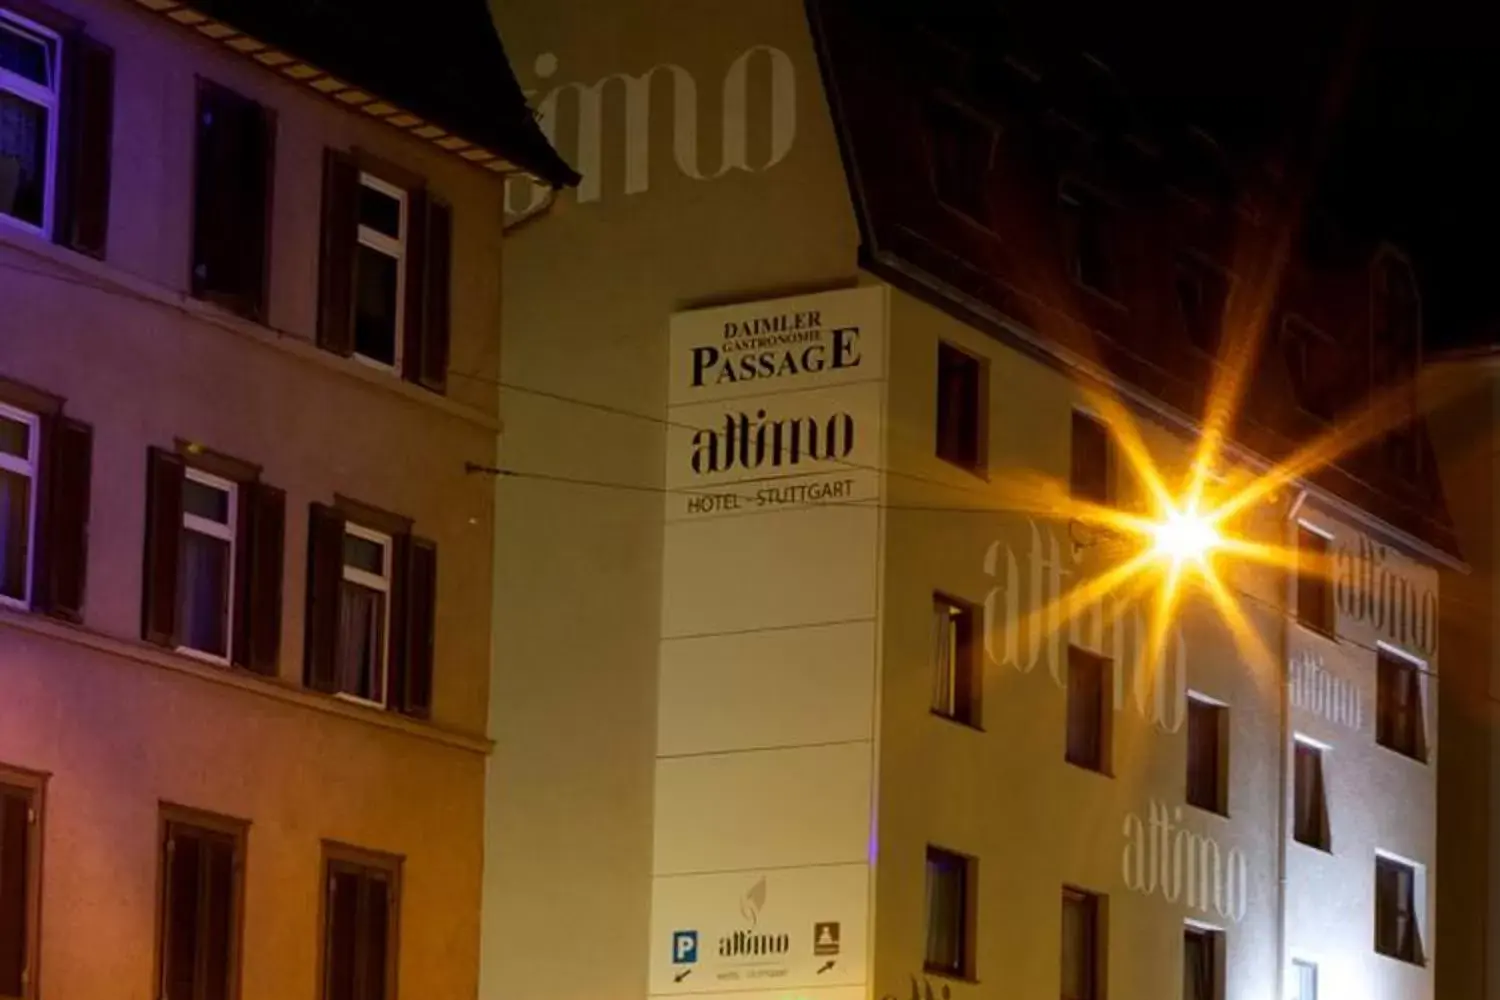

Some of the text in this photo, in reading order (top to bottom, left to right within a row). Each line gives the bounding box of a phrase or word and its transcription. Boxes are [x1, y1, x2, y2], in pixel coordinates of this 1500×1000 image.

[721, 330, 823, 353] GASTRONOMIE
[724, 311, 822, 340] DAIMLER
[690, 326, 862, 388] PASSAGE
[691, 408, 854, 475] attimo
[687, 479, 855, 514] HOTEL STUTTGART
[1122, 798, 1247, 923] attimo
